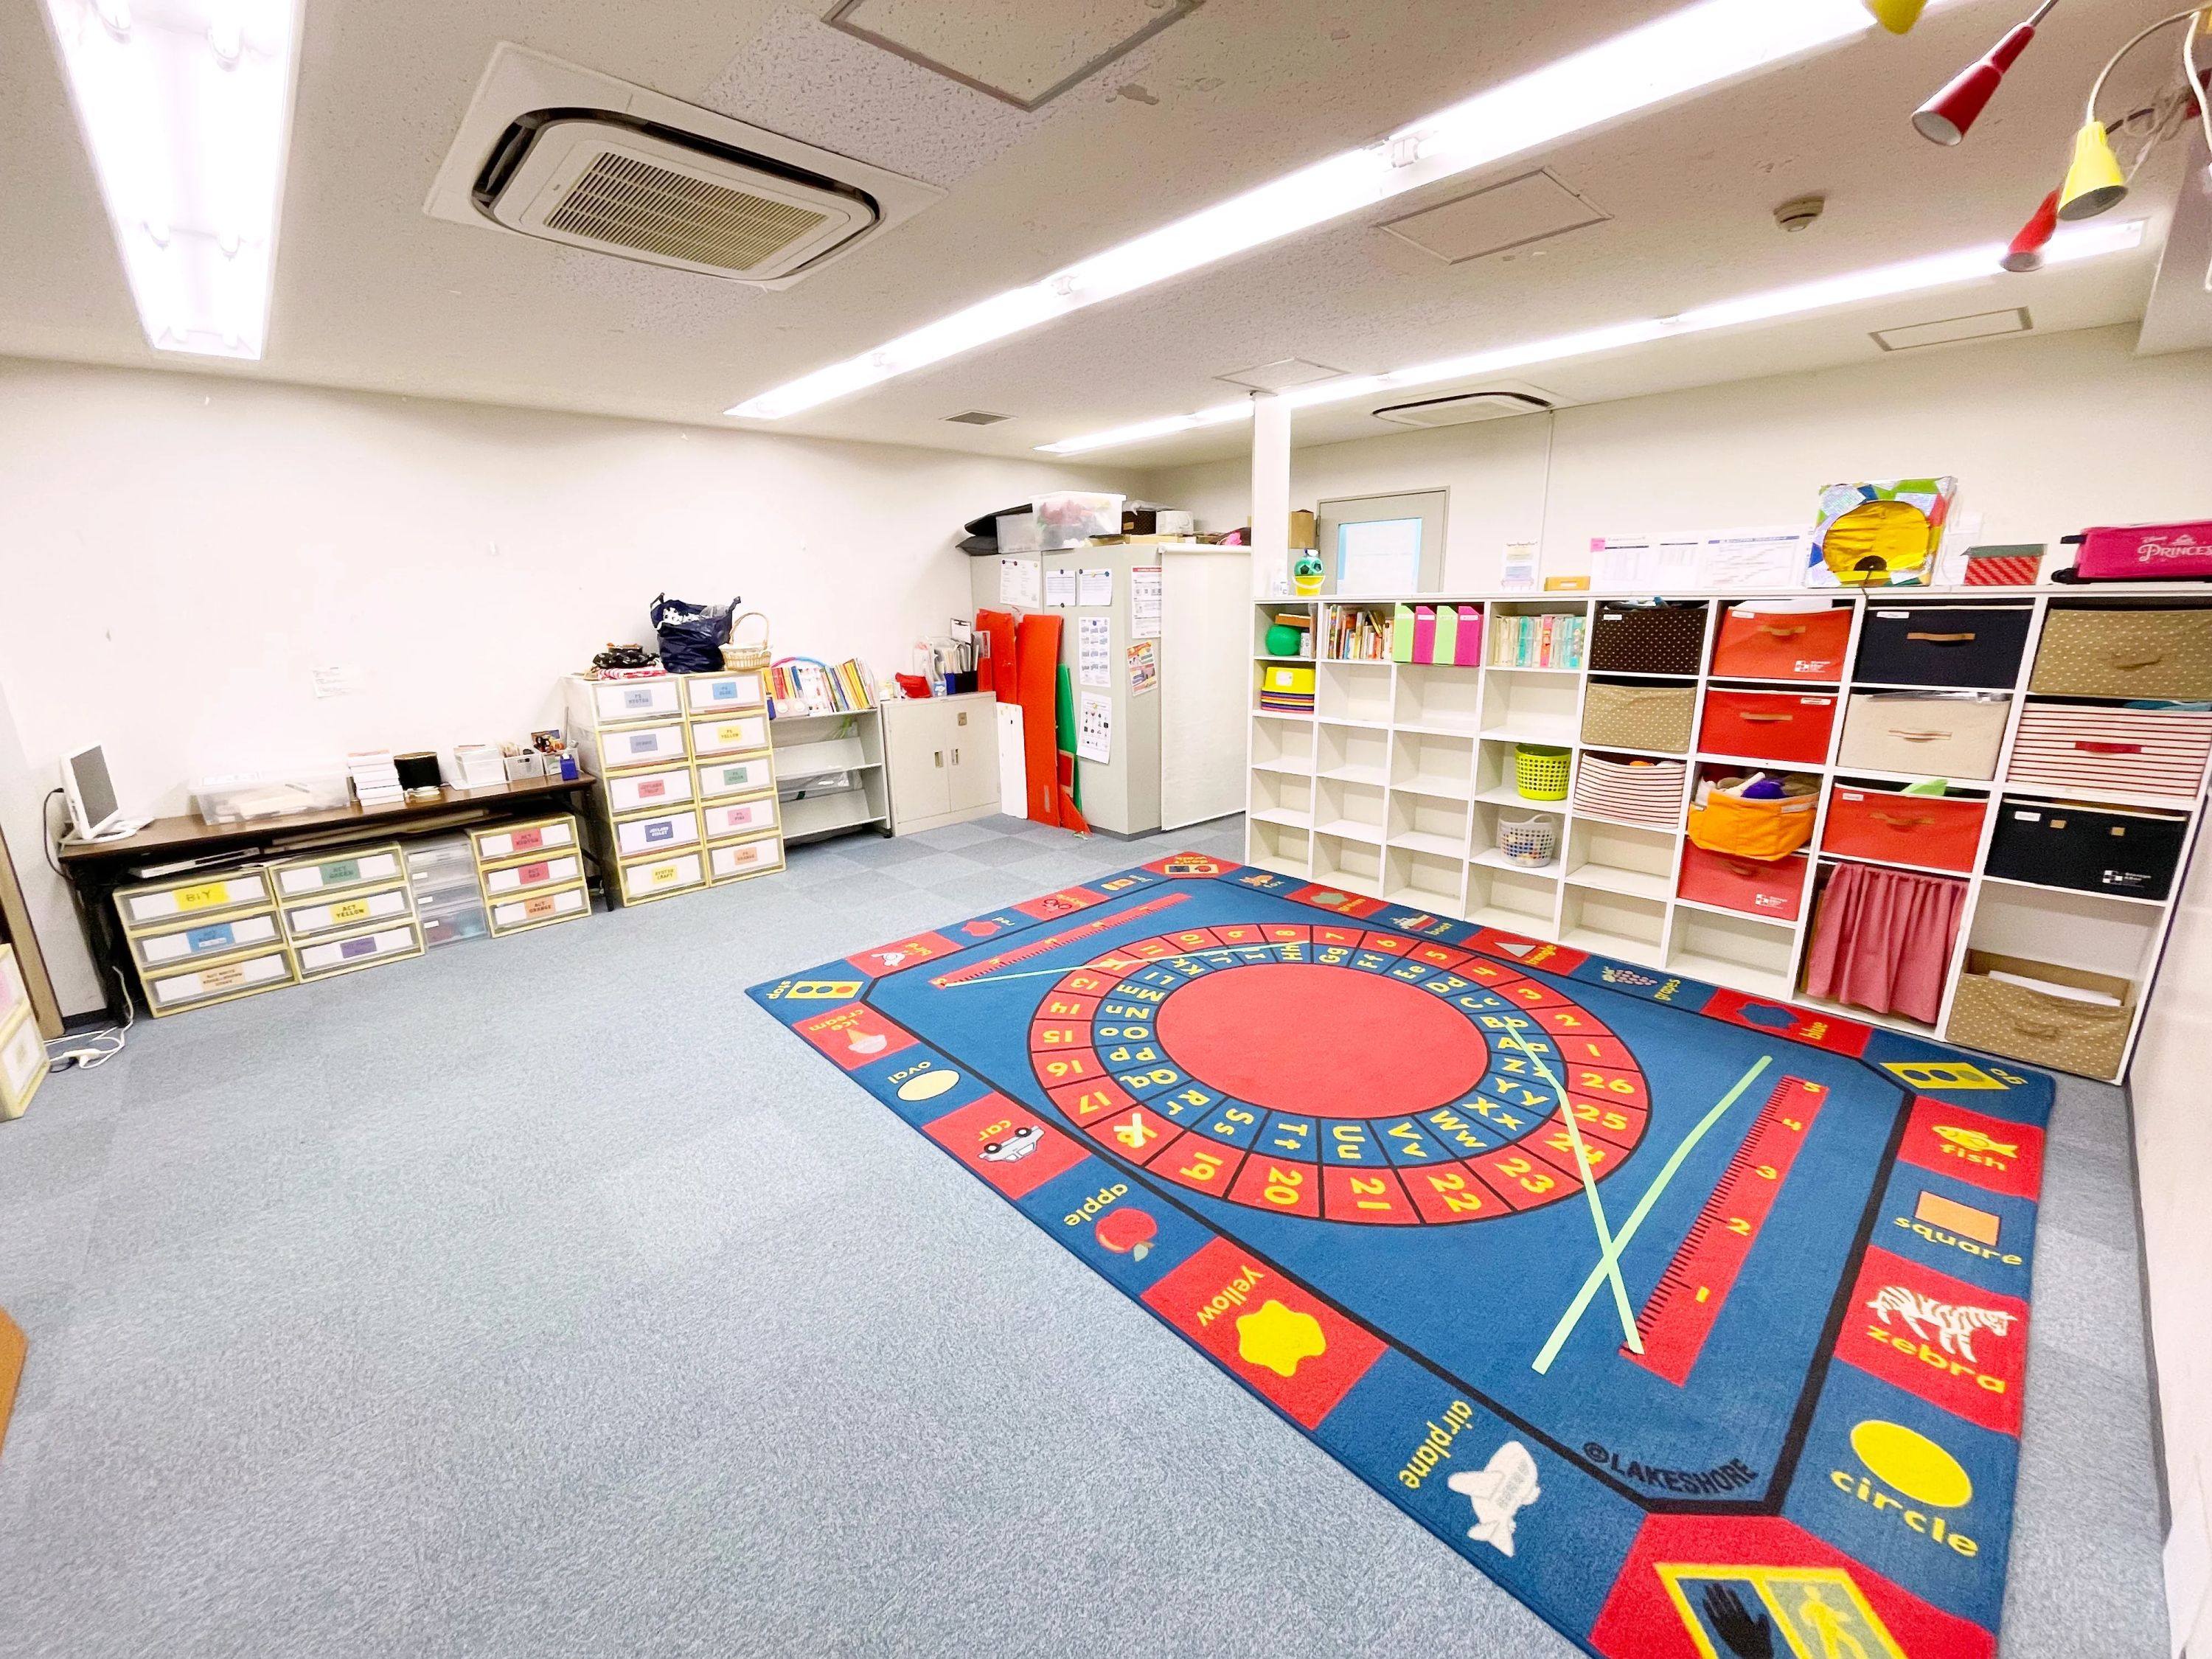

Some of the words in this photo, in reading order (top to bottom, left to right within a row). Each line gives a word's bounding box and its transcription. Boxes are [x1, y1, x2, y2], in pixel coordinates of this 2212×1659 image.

[1265, 880, 1285, 888] fox
[336, 909, 364, 917] YELLOW
[529, 905, 552, 913] ORANGE
[1338, 897, 1366, 912] green
[992, 917, 1015, 925] red
[1428, 923, 1452, 935] boat
[1180, 934, 1203, 944] 10
[1228, 931, 1245, 939] 9
[905, 943, 933, 956] bird
[1141, 946, 1164, 955] 11
[1319, 947, 1349, 963] Gg
[1524, 945, 1556, 964] triangle
[1173, 957, 1204, 975] Kk
[1357, 954, 1383, 968] Ff
[1393, 966, 1425, 978] Ee
[1473, 967, 1497, 975] 4
[766, 980, 791, 999] stop
[1070, 978, 1100, 990] 13
[1116, 984, 1166, 1002] Mm
[1425, 977, 1467, 992] Dd
[1655, 979, 1680, 1001] grapes
[1461, 998, 1500, 1008] Cc
[1518, 989, 1542, 999] 3
[1050, 1001, 1080, 1015] 14
[1105, 1005, 1150, 1019] Nn
[809, 1009, 863, 1030] cream
[832, 1021, 858, 1030] ice
[1481, 1016, 1528, 1027] Bb
[1555, 1015, 1581, 1026] 2
[1043, 1030, 1073, 1043] 15
[1099, 1026, 1149, 1039] Oo
[1800, 1022, 1827, 1040] blue
[1498, 1037, 1549, 1052] Aa
[1587, 1044, 1601, 1057] 1
[1110, 1047, 1156, 1061] Pp
[888, 1062, 931, 1084] oval
[1046, 1060, 1083, 1077] 16
[1991, 1068, 2028, 1084] go
[1119, 1069, 1178, 1088] Qq
[1581, 1073, 1635, 1093] 26
[1804, 1082, 1820, 1092] 5
[1495, 1078, 1550, 1106] Yy
[1079, 1091, 1112, 1114] 17
[1166, 1090, 1210, 1115] Rr
[1214, 1108, 1253, 1135] Ss
[1463, 1097, 1524, 1130] Xx
[1573, 1105, 1627, 1130] 25
[978, 1120, 1012, 1141] car
[1430, 1110, 1486, 1147] Ww
[1783, 1119, 1801, 1130] 4
[1274, 1124, 1307, 1150] Tt
[1333, 1126, 1365, 1158] Uu
[1388, 1122, 1427, 1157] Vv
[1545, 1133, 1606, 1165] 24
[1941, 1143, 2006, 1170] fish
[1180, 1152, 1223, 1180] 19
[1756, 1166, 1776, 1179] 3
[1494, 1158, 1554, 1193] 23
[1265, 1166, 1303, 1204] 20
[1350, 1178, 1391, 1209] 21
[1427, 1173, 1481, 1212] 22
[1064, 1184, 1128, 1225] apple
[1727, 1218, 1750, 1236] 2
[1894, 1215, 2022, 1265] square
[1197, 1265, 1265, 1326] yellow
[1696, 1287, 1710, 1302] 1
[1868, 1326, 2005, 1392] zebra
[1399, 1401, 1473, 1489] airplane
[1832, 1469, 1977, 1556] circle
